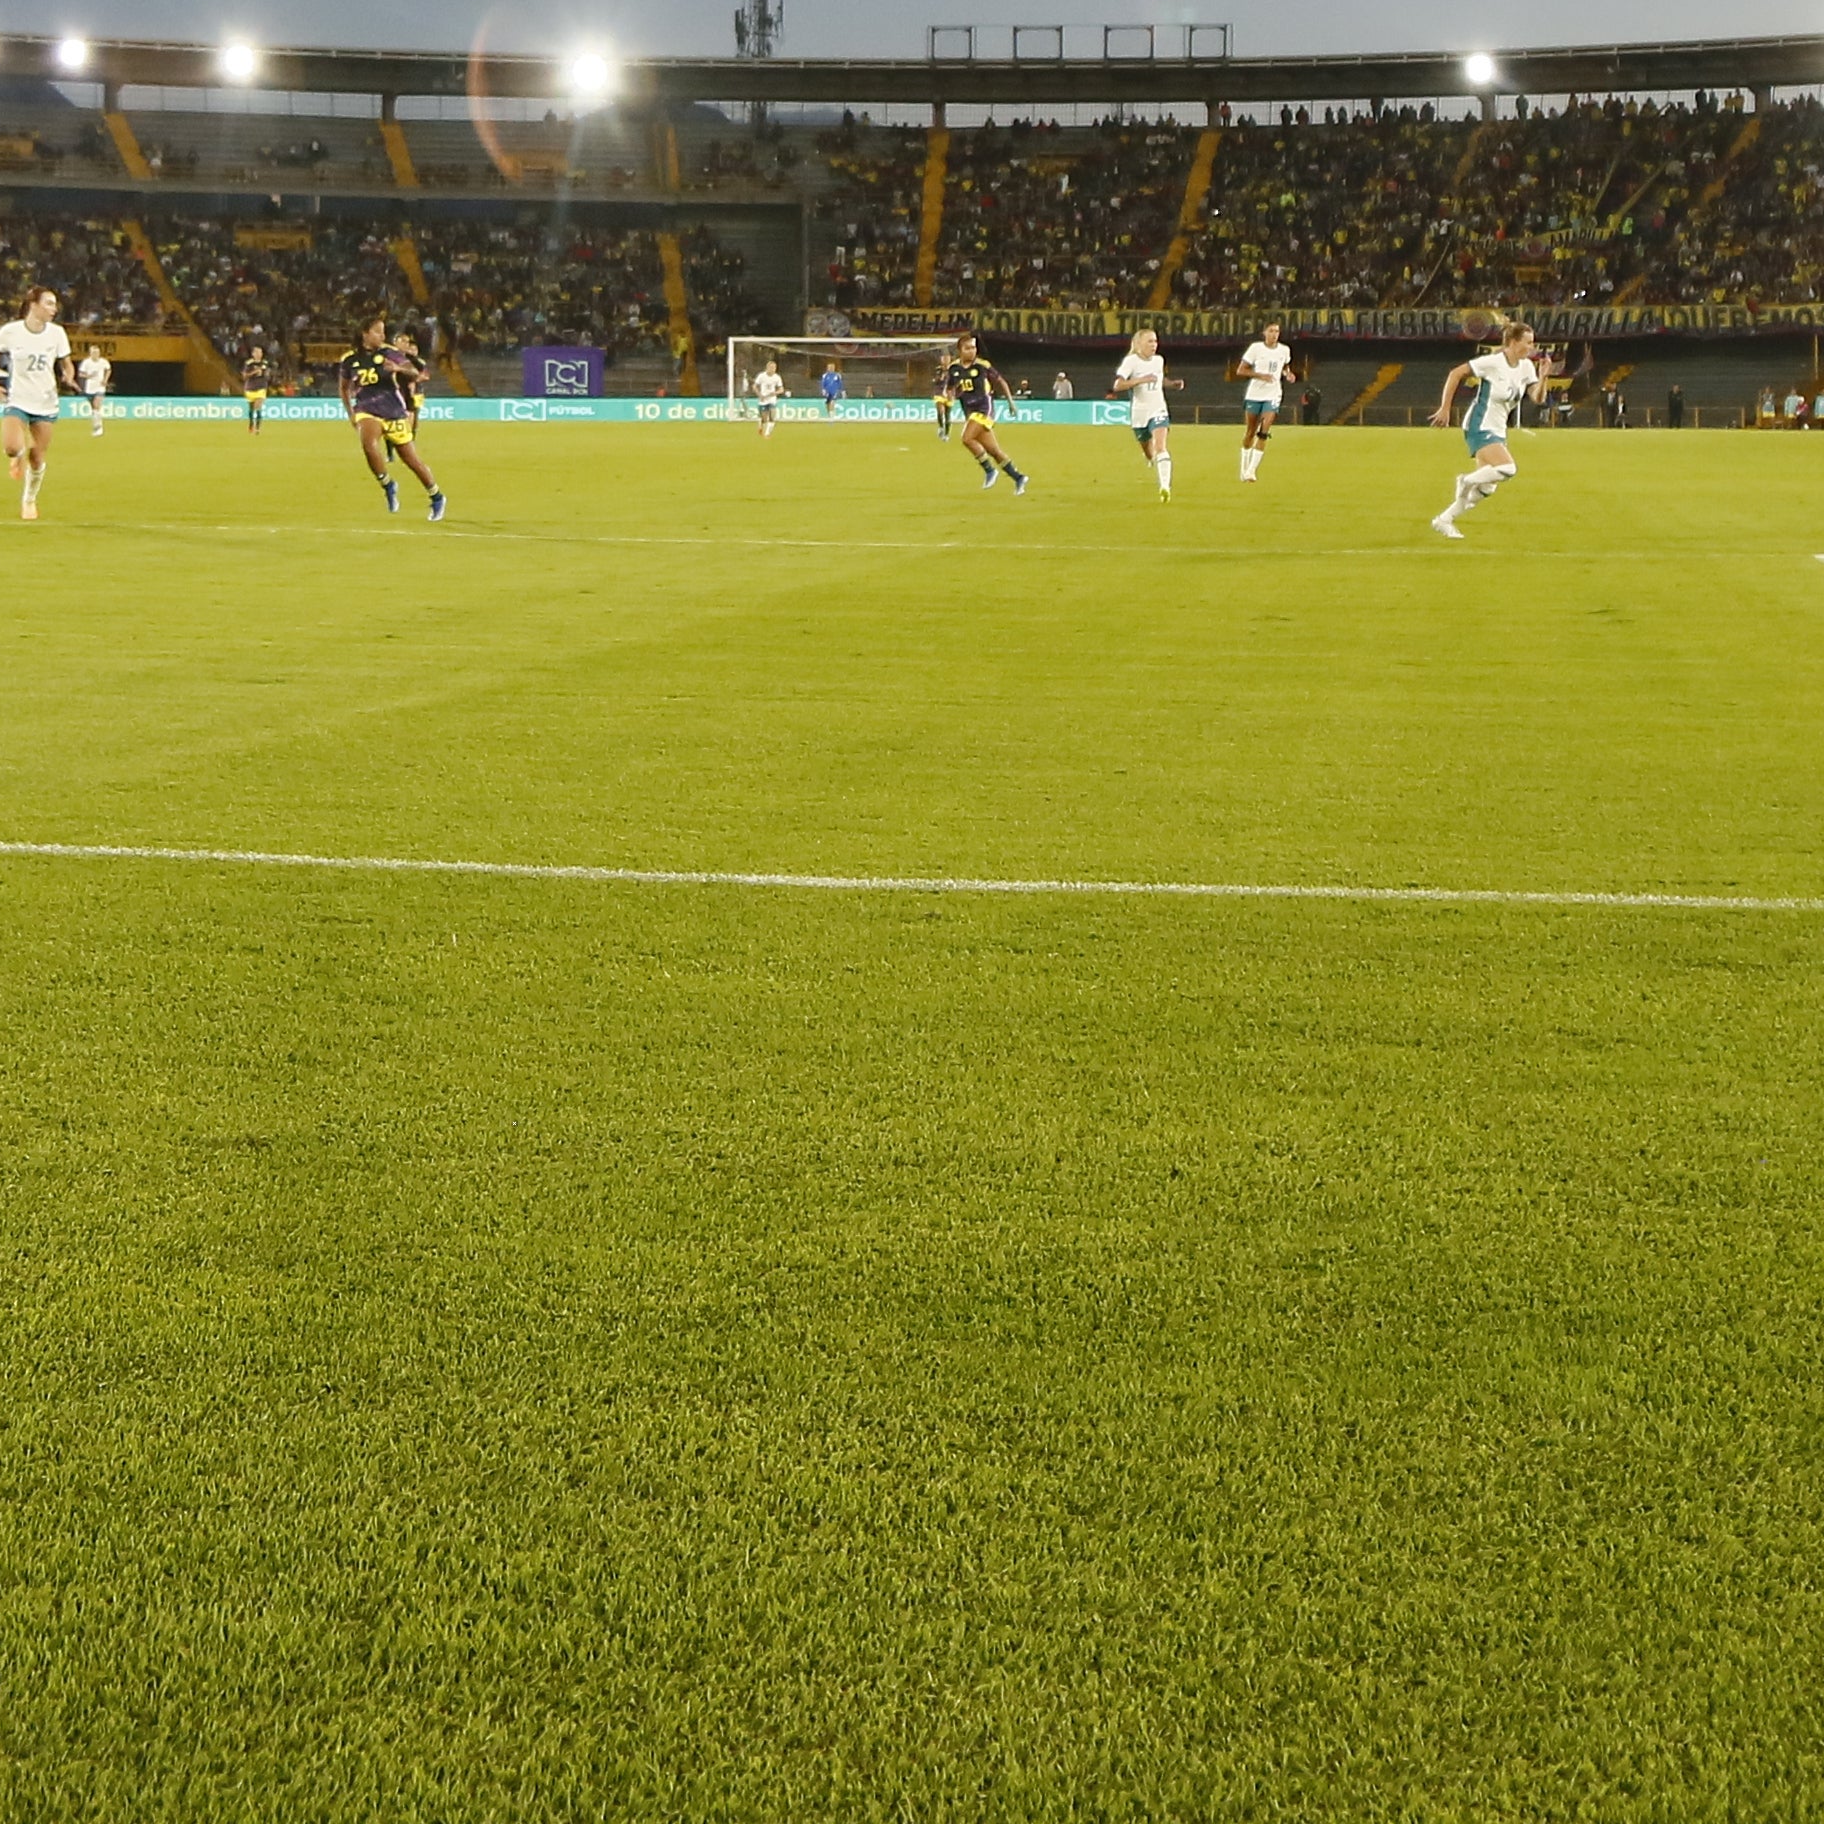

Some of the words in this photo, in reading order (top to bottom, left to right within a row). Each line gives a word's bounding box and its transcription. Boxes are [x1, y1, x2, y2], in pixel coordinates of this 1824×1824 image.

[980, 309, 1107, 336] COLOMBIA
[27, 355, 46, 372] 25
[357, 368, 379, 386] 26
[958, 379, 973, 392] 10
[132, 401, 243, 418] diciembre
[635, 403, 661, 419] 10
[667, 404, 697, 419] de
